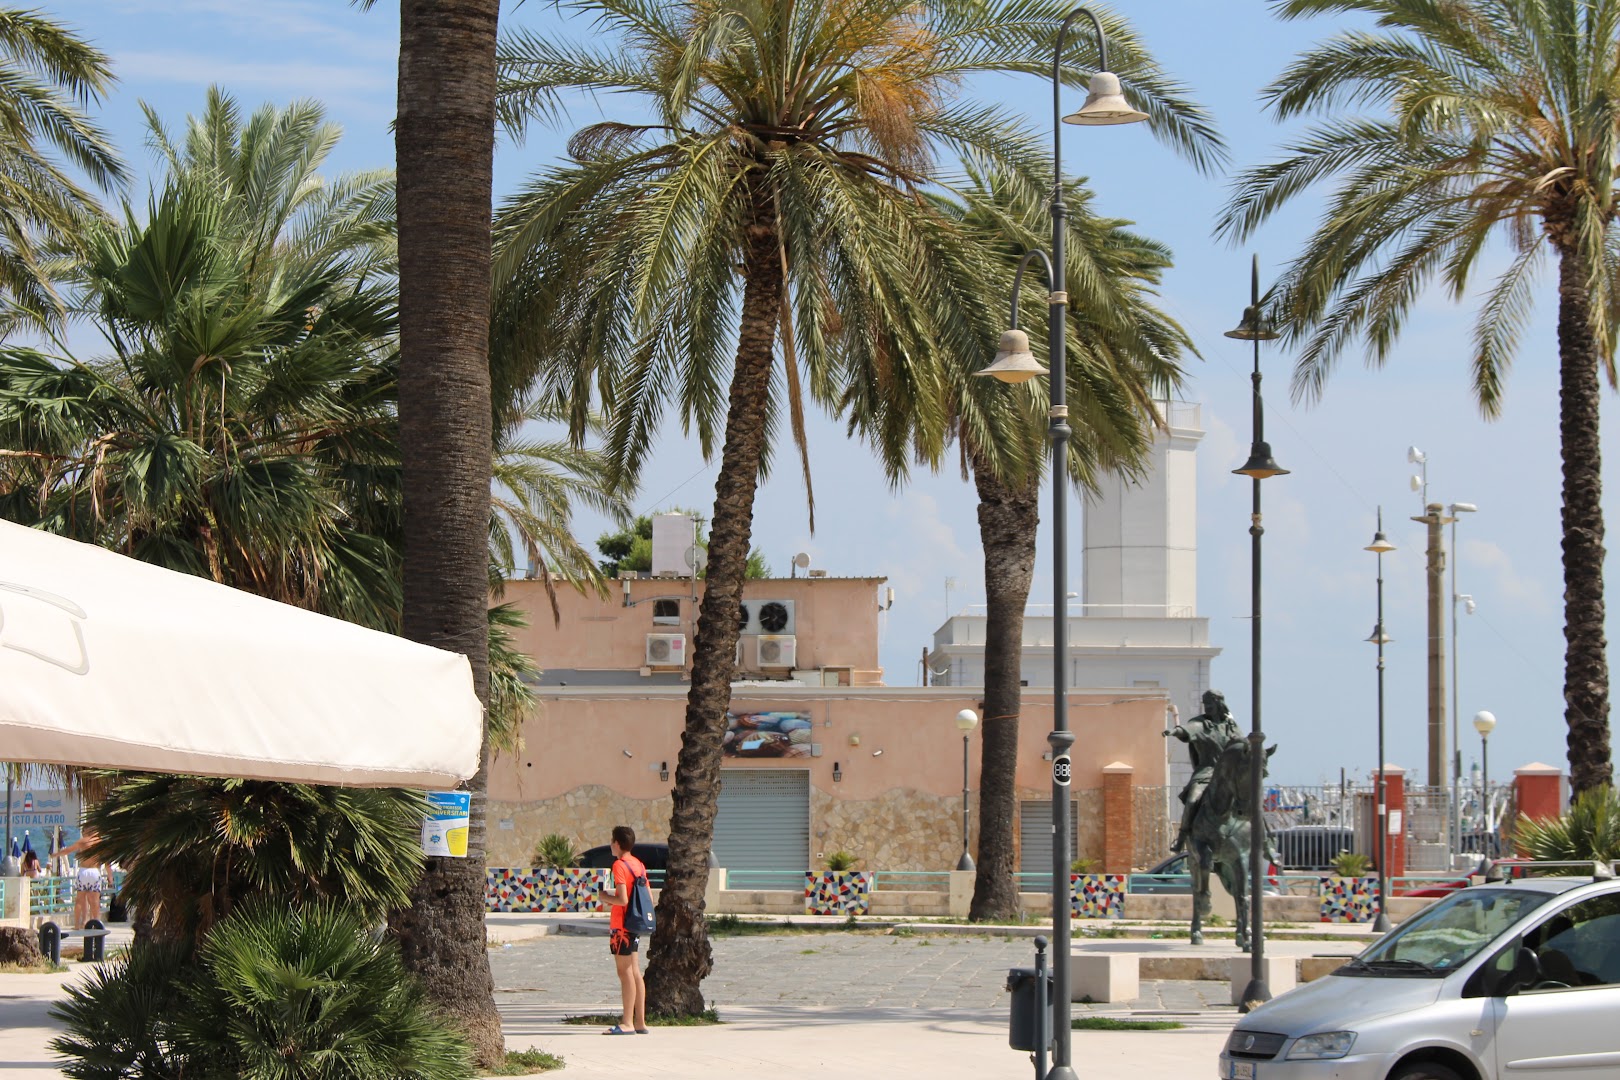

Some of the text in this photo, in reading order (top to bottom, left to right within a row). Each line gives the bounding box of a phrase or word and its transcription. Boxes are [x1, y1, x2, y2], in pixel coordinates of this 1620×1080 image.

[5, 815, 30, 824] PSTO
[32, 815, 42, 824] AL
[45, 814, 65, 824] FARO
